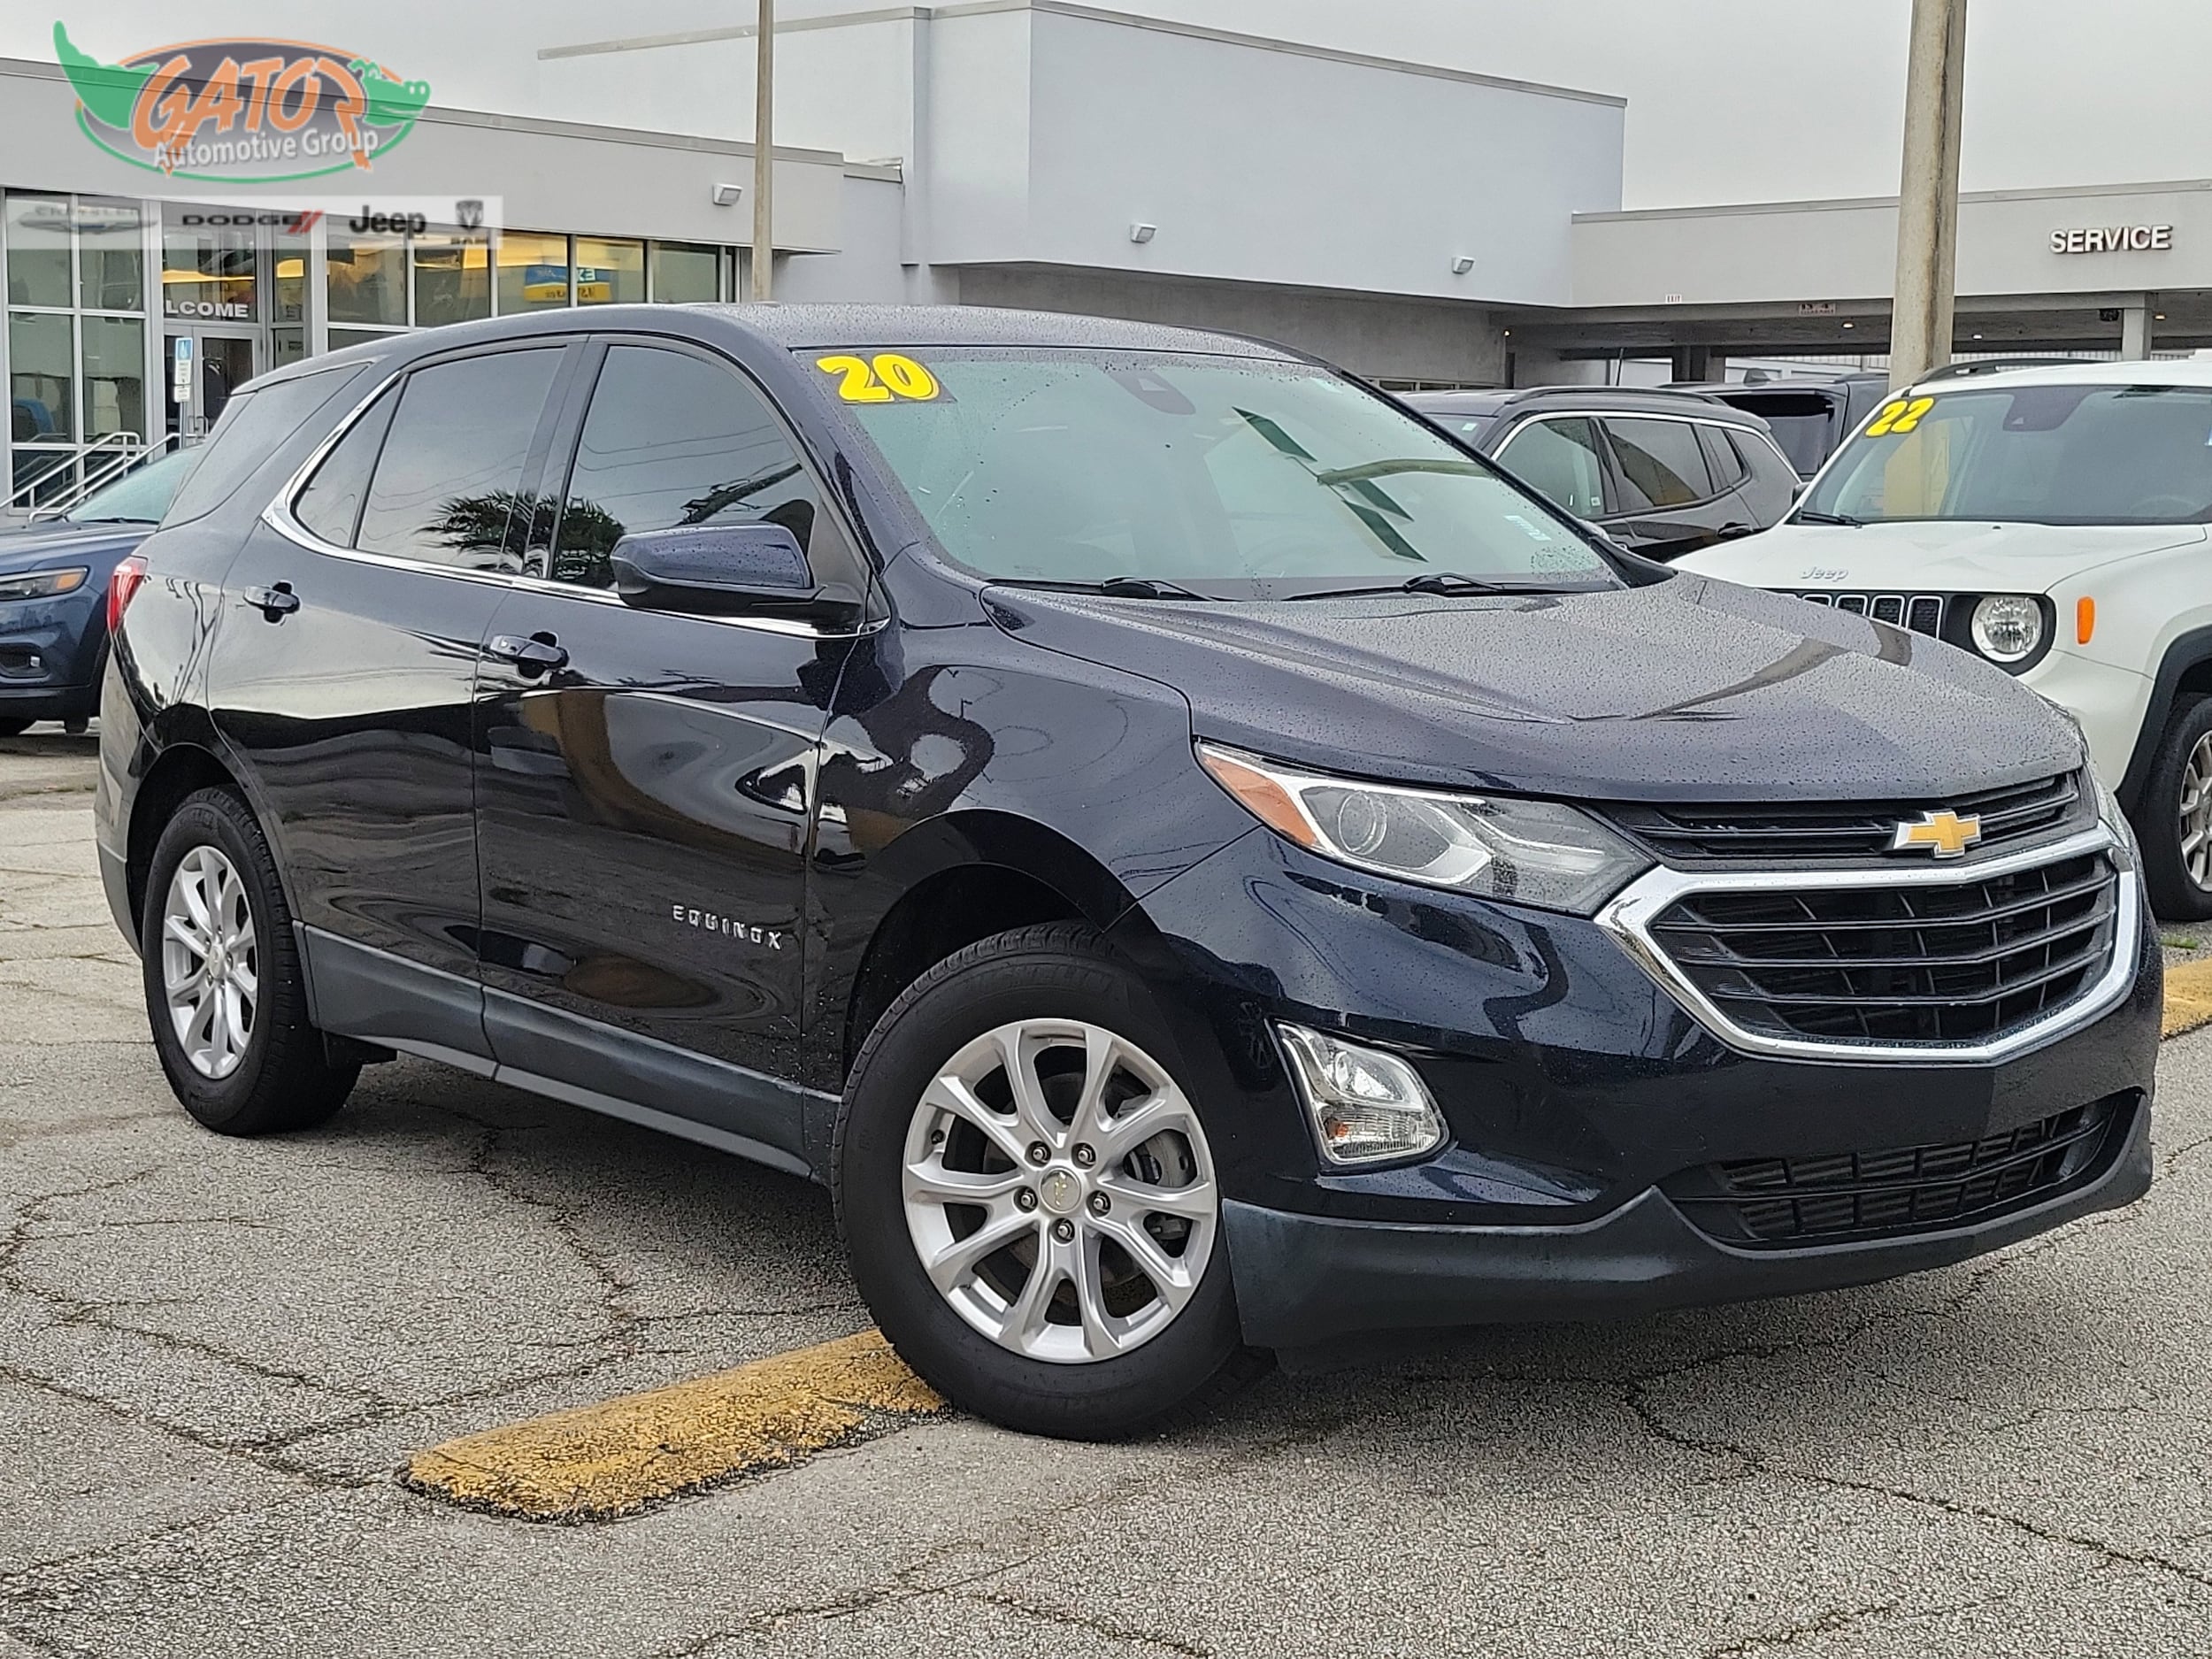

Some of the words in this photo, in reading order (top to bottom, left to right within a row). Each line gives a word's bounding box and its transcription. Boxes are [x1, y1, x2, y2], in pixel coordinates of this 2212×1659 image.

[2049, 225, 2173, 254] SERVICE
[165, 299, 249, 319] LCOME
[816, 354, 941, 403] 20
[1865, 397, 1934, 437] 22
[1801, 565, 1849, 583] Jeep
[672, 904, 781, 950] EQUINOX
